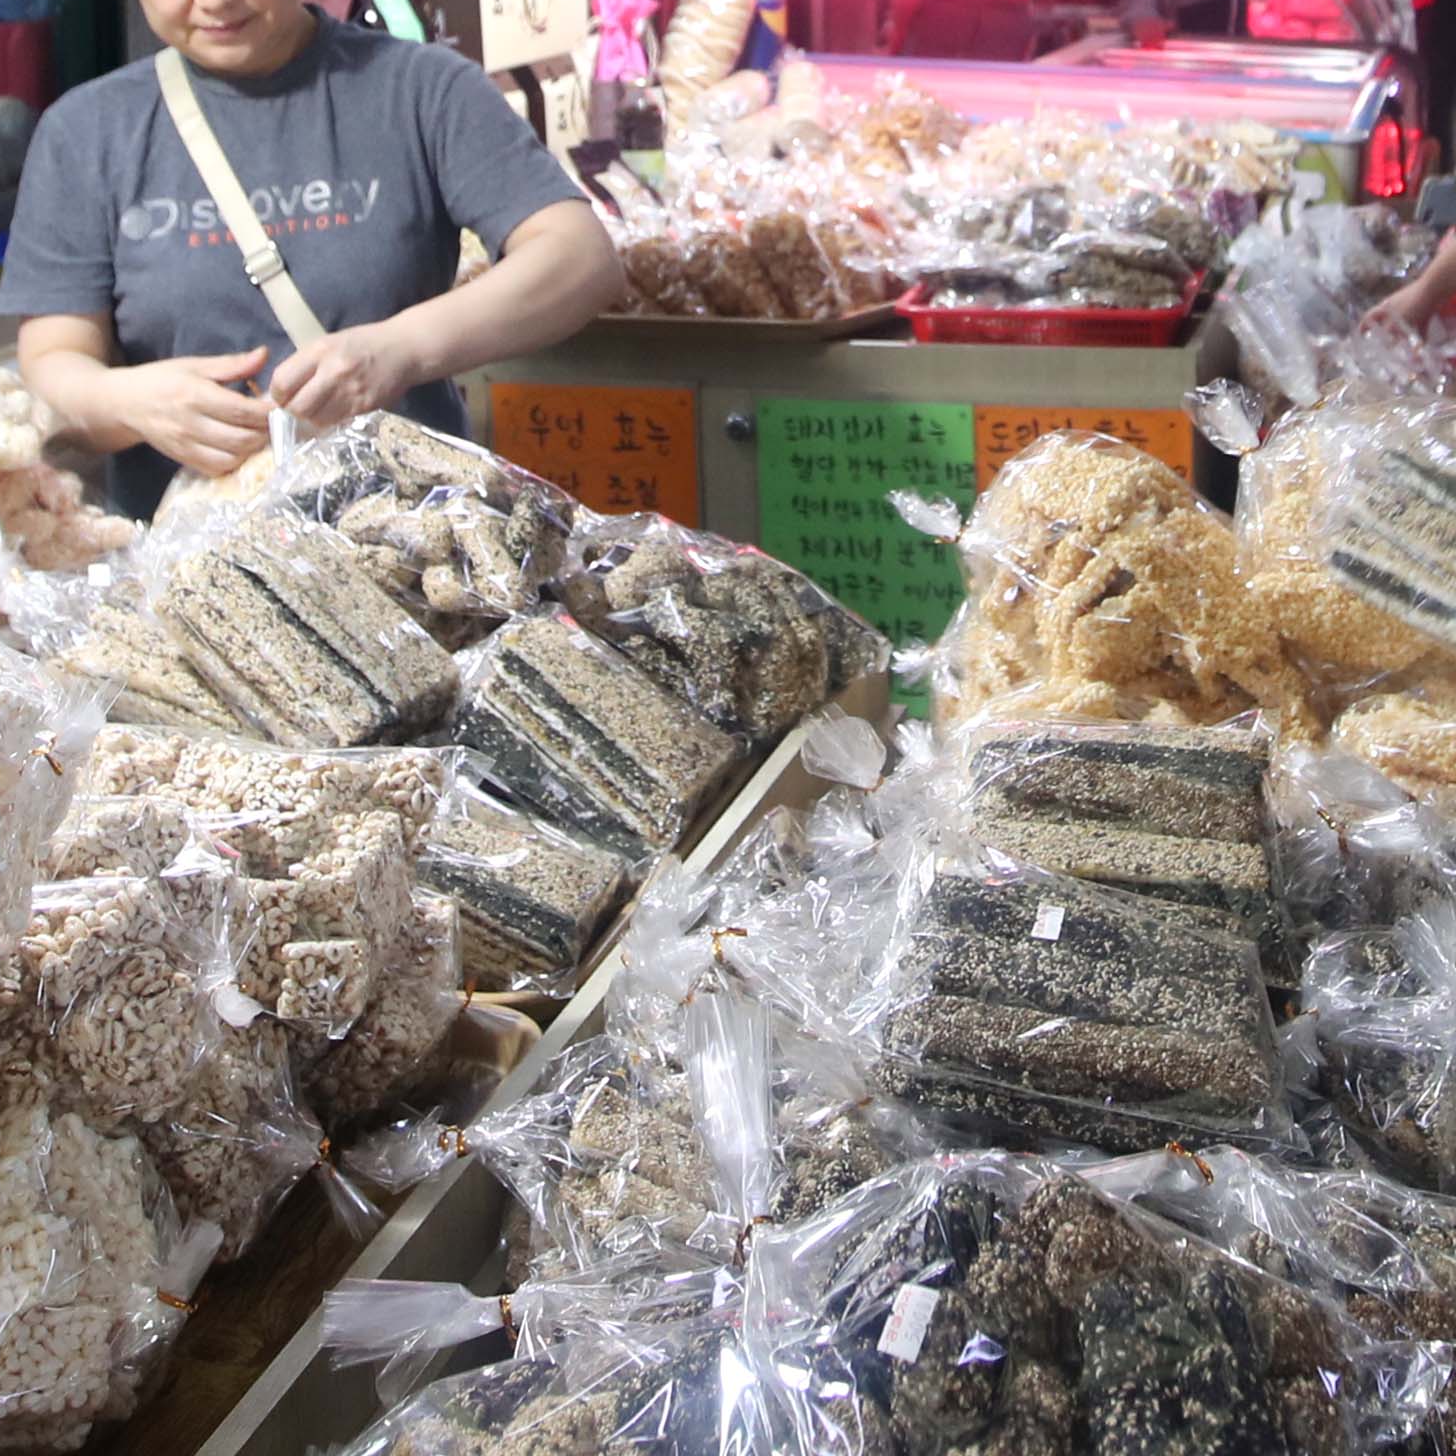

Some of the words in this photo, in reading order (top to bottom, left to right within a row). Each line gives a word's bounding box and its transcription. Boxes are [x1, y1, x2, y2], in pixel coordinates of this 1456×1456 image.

[140, 177, 380, 239] Disovery
[528, 404, 587, 450] 우엉
[611, 410, 672, 456] 효능
